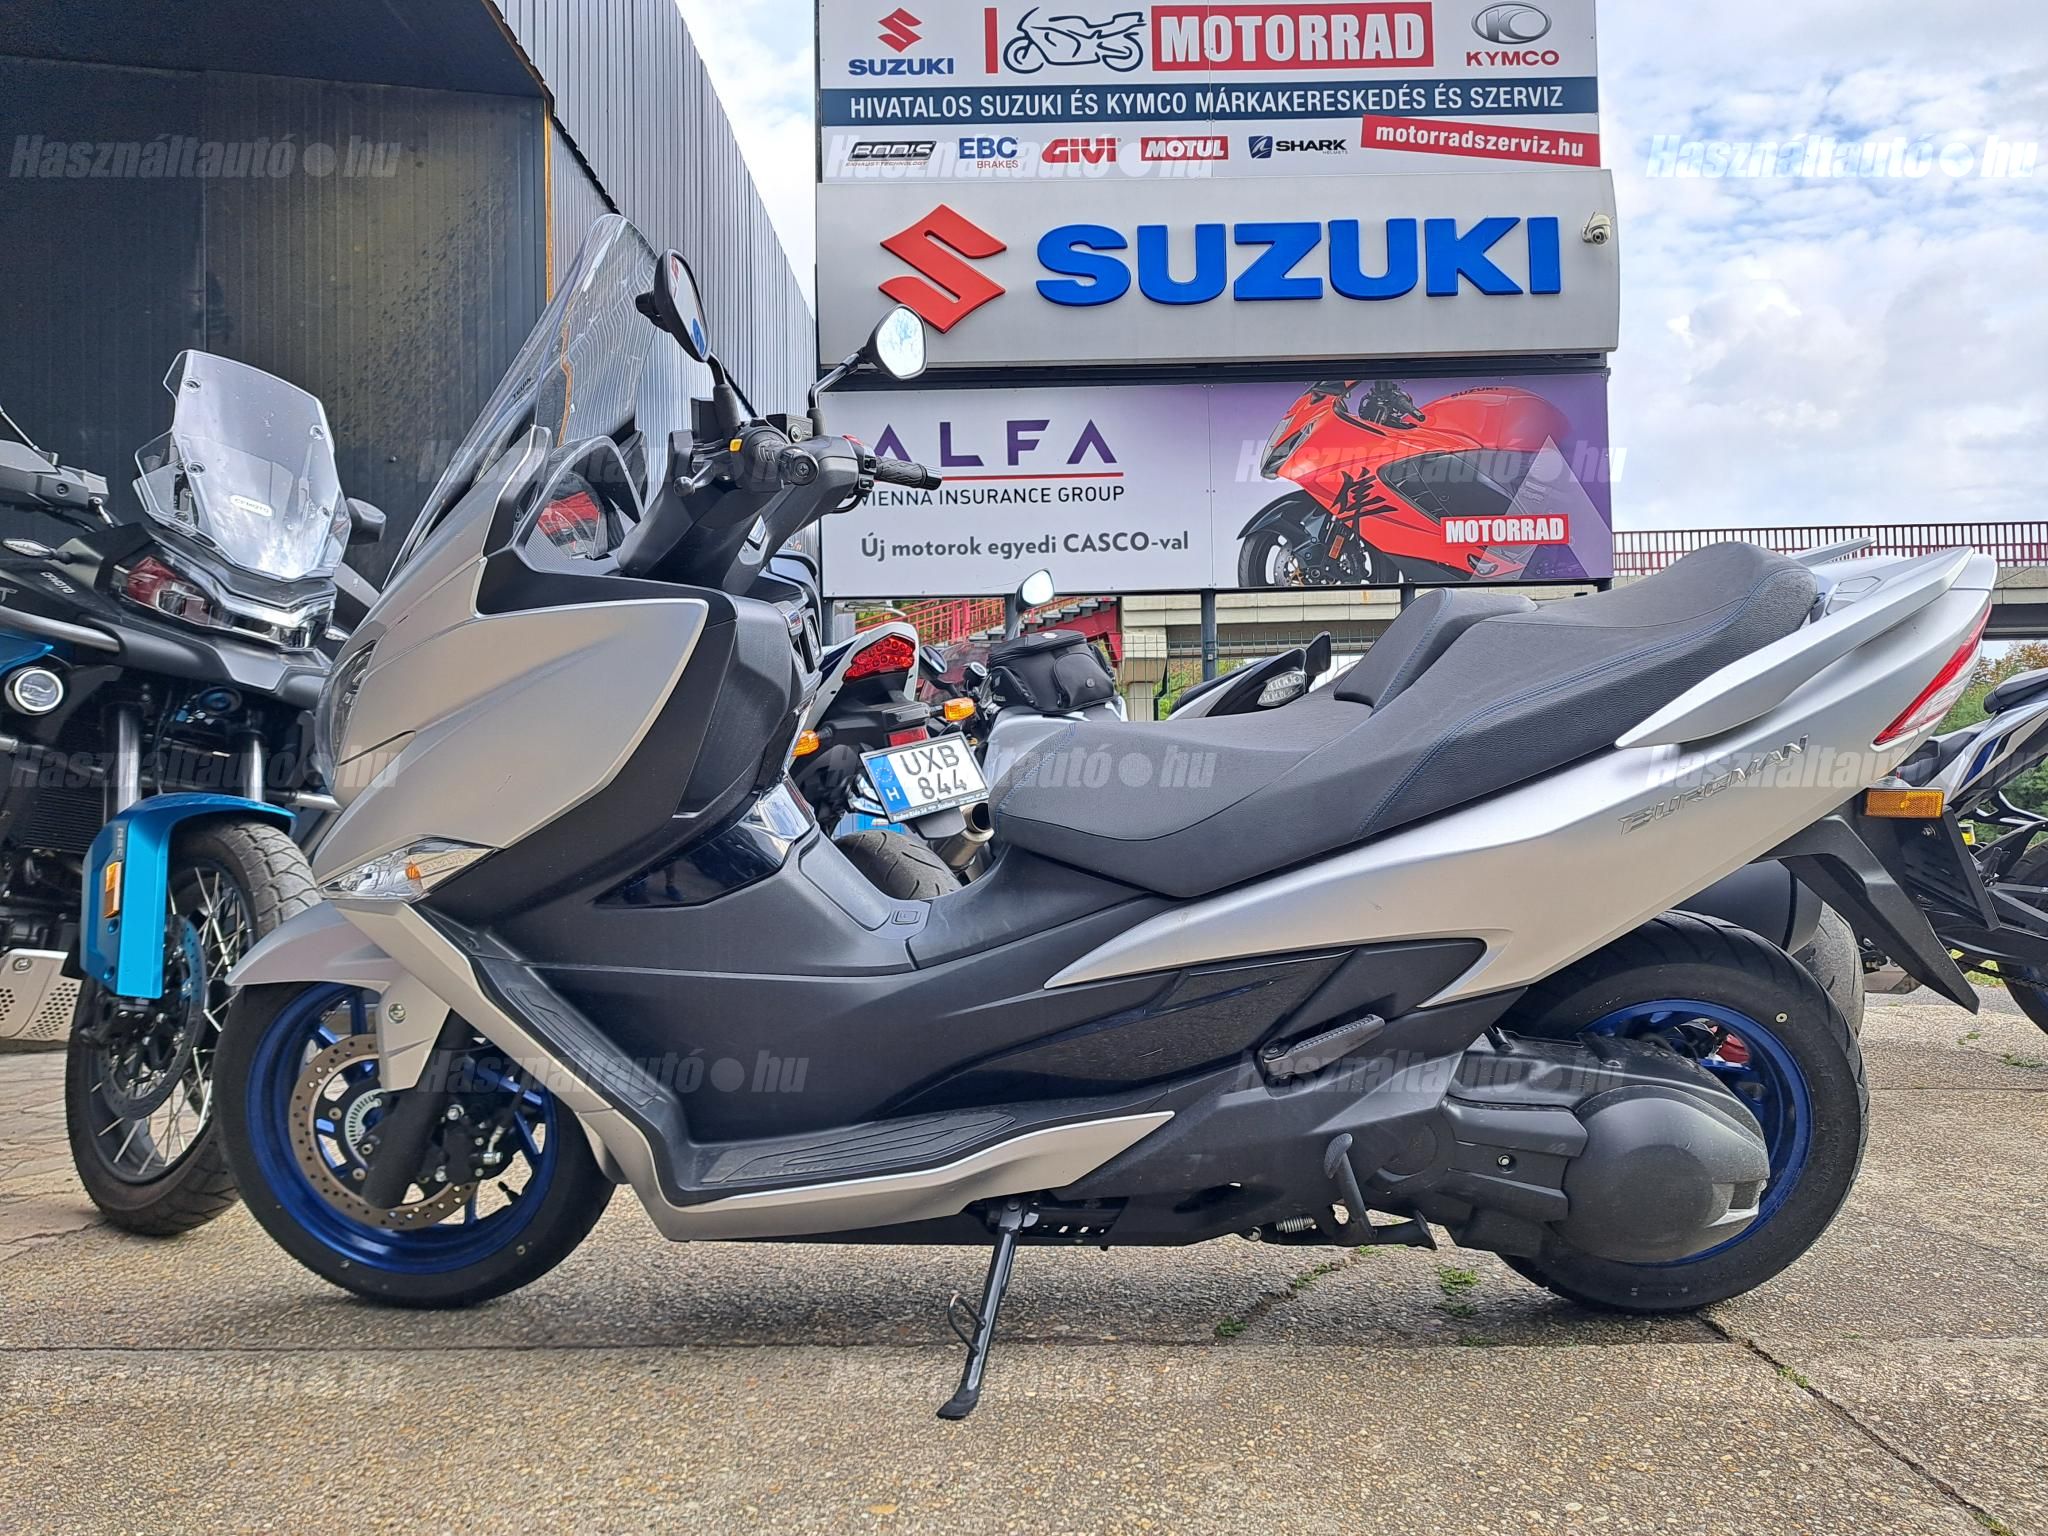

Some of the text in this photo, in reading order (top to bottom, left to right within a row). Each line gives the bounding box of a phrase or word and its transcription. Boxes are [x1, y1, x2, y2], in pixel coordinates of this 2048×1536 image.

[1160, 13, 1425, 63] MOTORRAD
[848, 57, 954, 76] SUZUKI
[1466, 49, 1560, 66] KYMCO
[850, 84, 1564, 118] HIVATALOS SUZUKI ÉS KYMCO MÁRKAKERESKEDÉS ÉS SZERVIZ
[959, 136, 1018, 159] EBC
[1041, 137, 1117, 164] GIVI
[1145, 139, 1225, 158] MOTUL
[1275, 139, 1347, 151] SHARK
[1375, 125, 1584, 158] motorradszerviz.hu
[976, 160, 1019, 169] BRAKES
[1034, 215, 1562, 307] SUZUKI
[1450, 386, 1501, 398] SUZUKI
[873, 418, 1118, 467] ALFA
[939, 488, 1052, 505] INSURANCE
[1058, 486, 1125, 503] GROUP
[1445, 517, 1564, 543] MOTORRAD
[861, 531, 1189, 562] Új motorok egyedi CASCO-val
[899, 744, 960, 776] UXB
[885, 787, 900, 801] H
[917, 769, 968, 800] 844
[1617, 733, 1809, 836] BURGMAN
